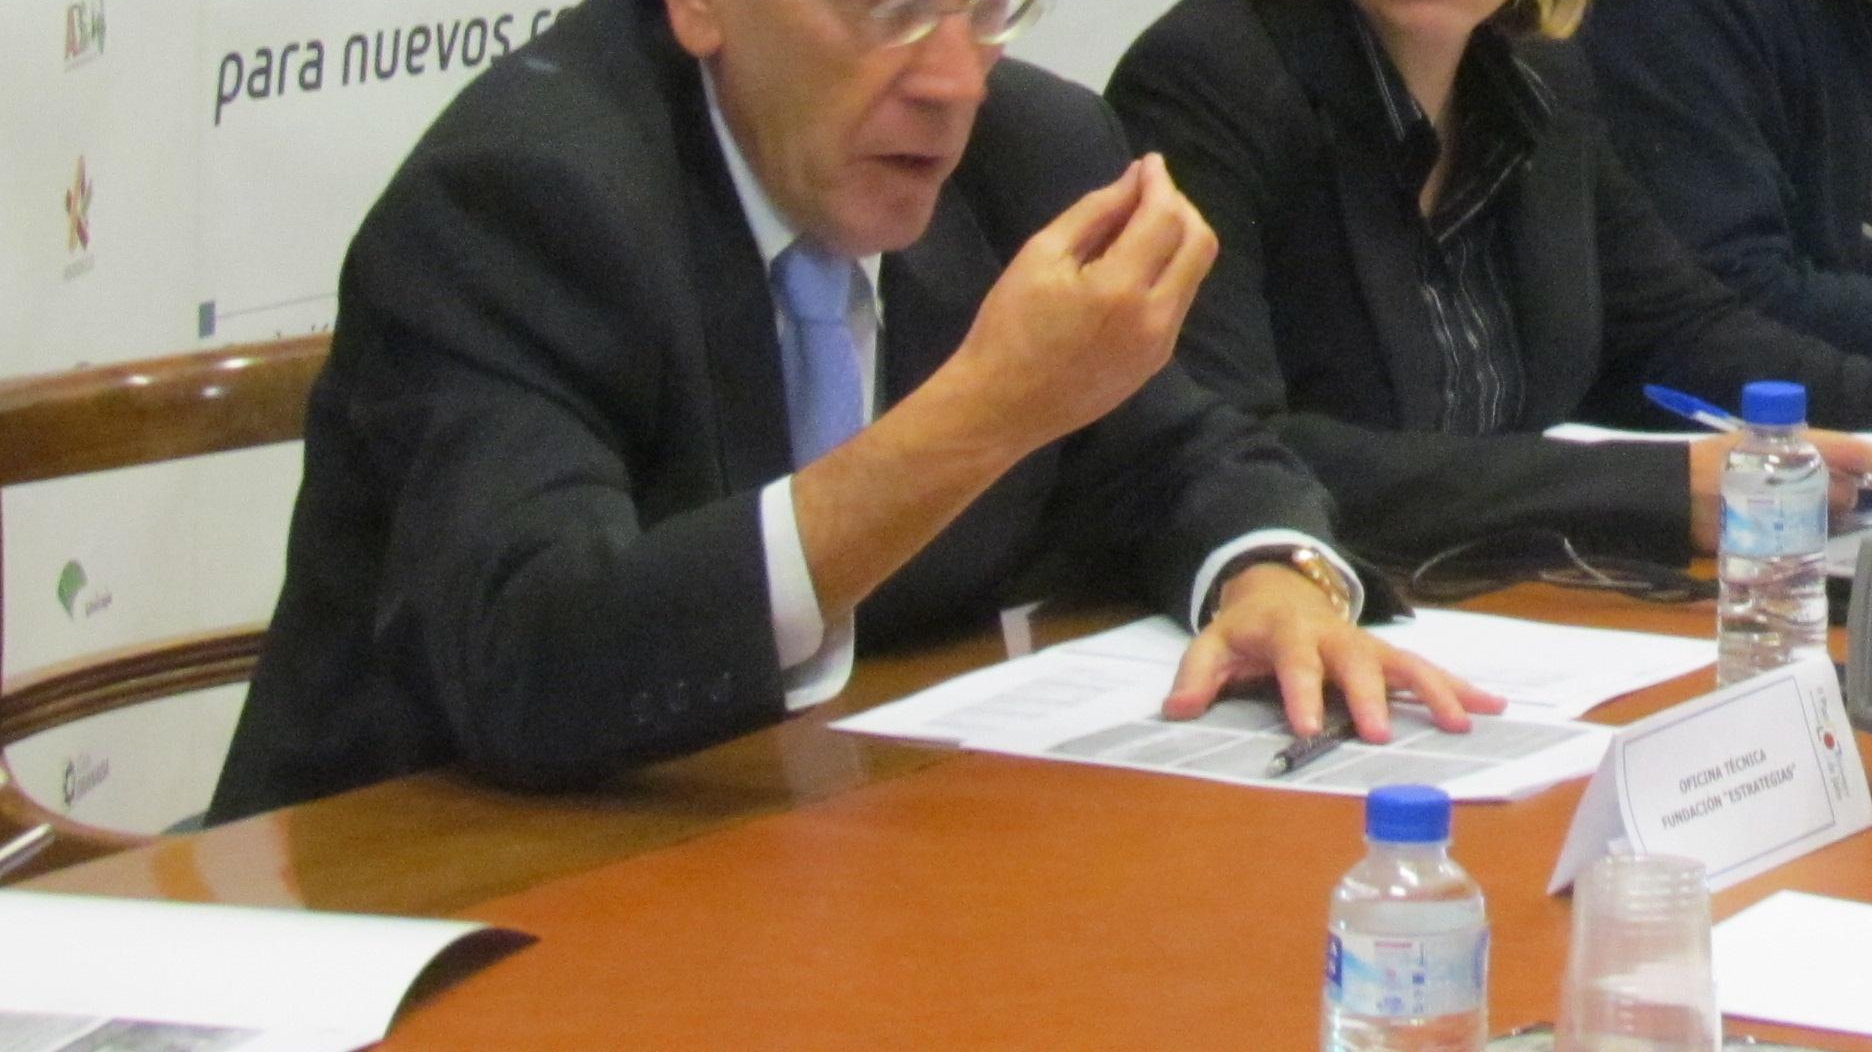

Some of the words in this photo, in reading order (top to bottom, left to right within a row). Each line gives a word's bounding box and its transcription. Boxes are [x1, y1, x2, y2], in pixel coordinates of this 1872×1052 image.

[213, 39, 325, 127] para
[341, 12, 514, 88] nuevos
[1679, 765, 1723, 795] OFICINA
[1722, 748, 1767, 777] TÉCNICA
